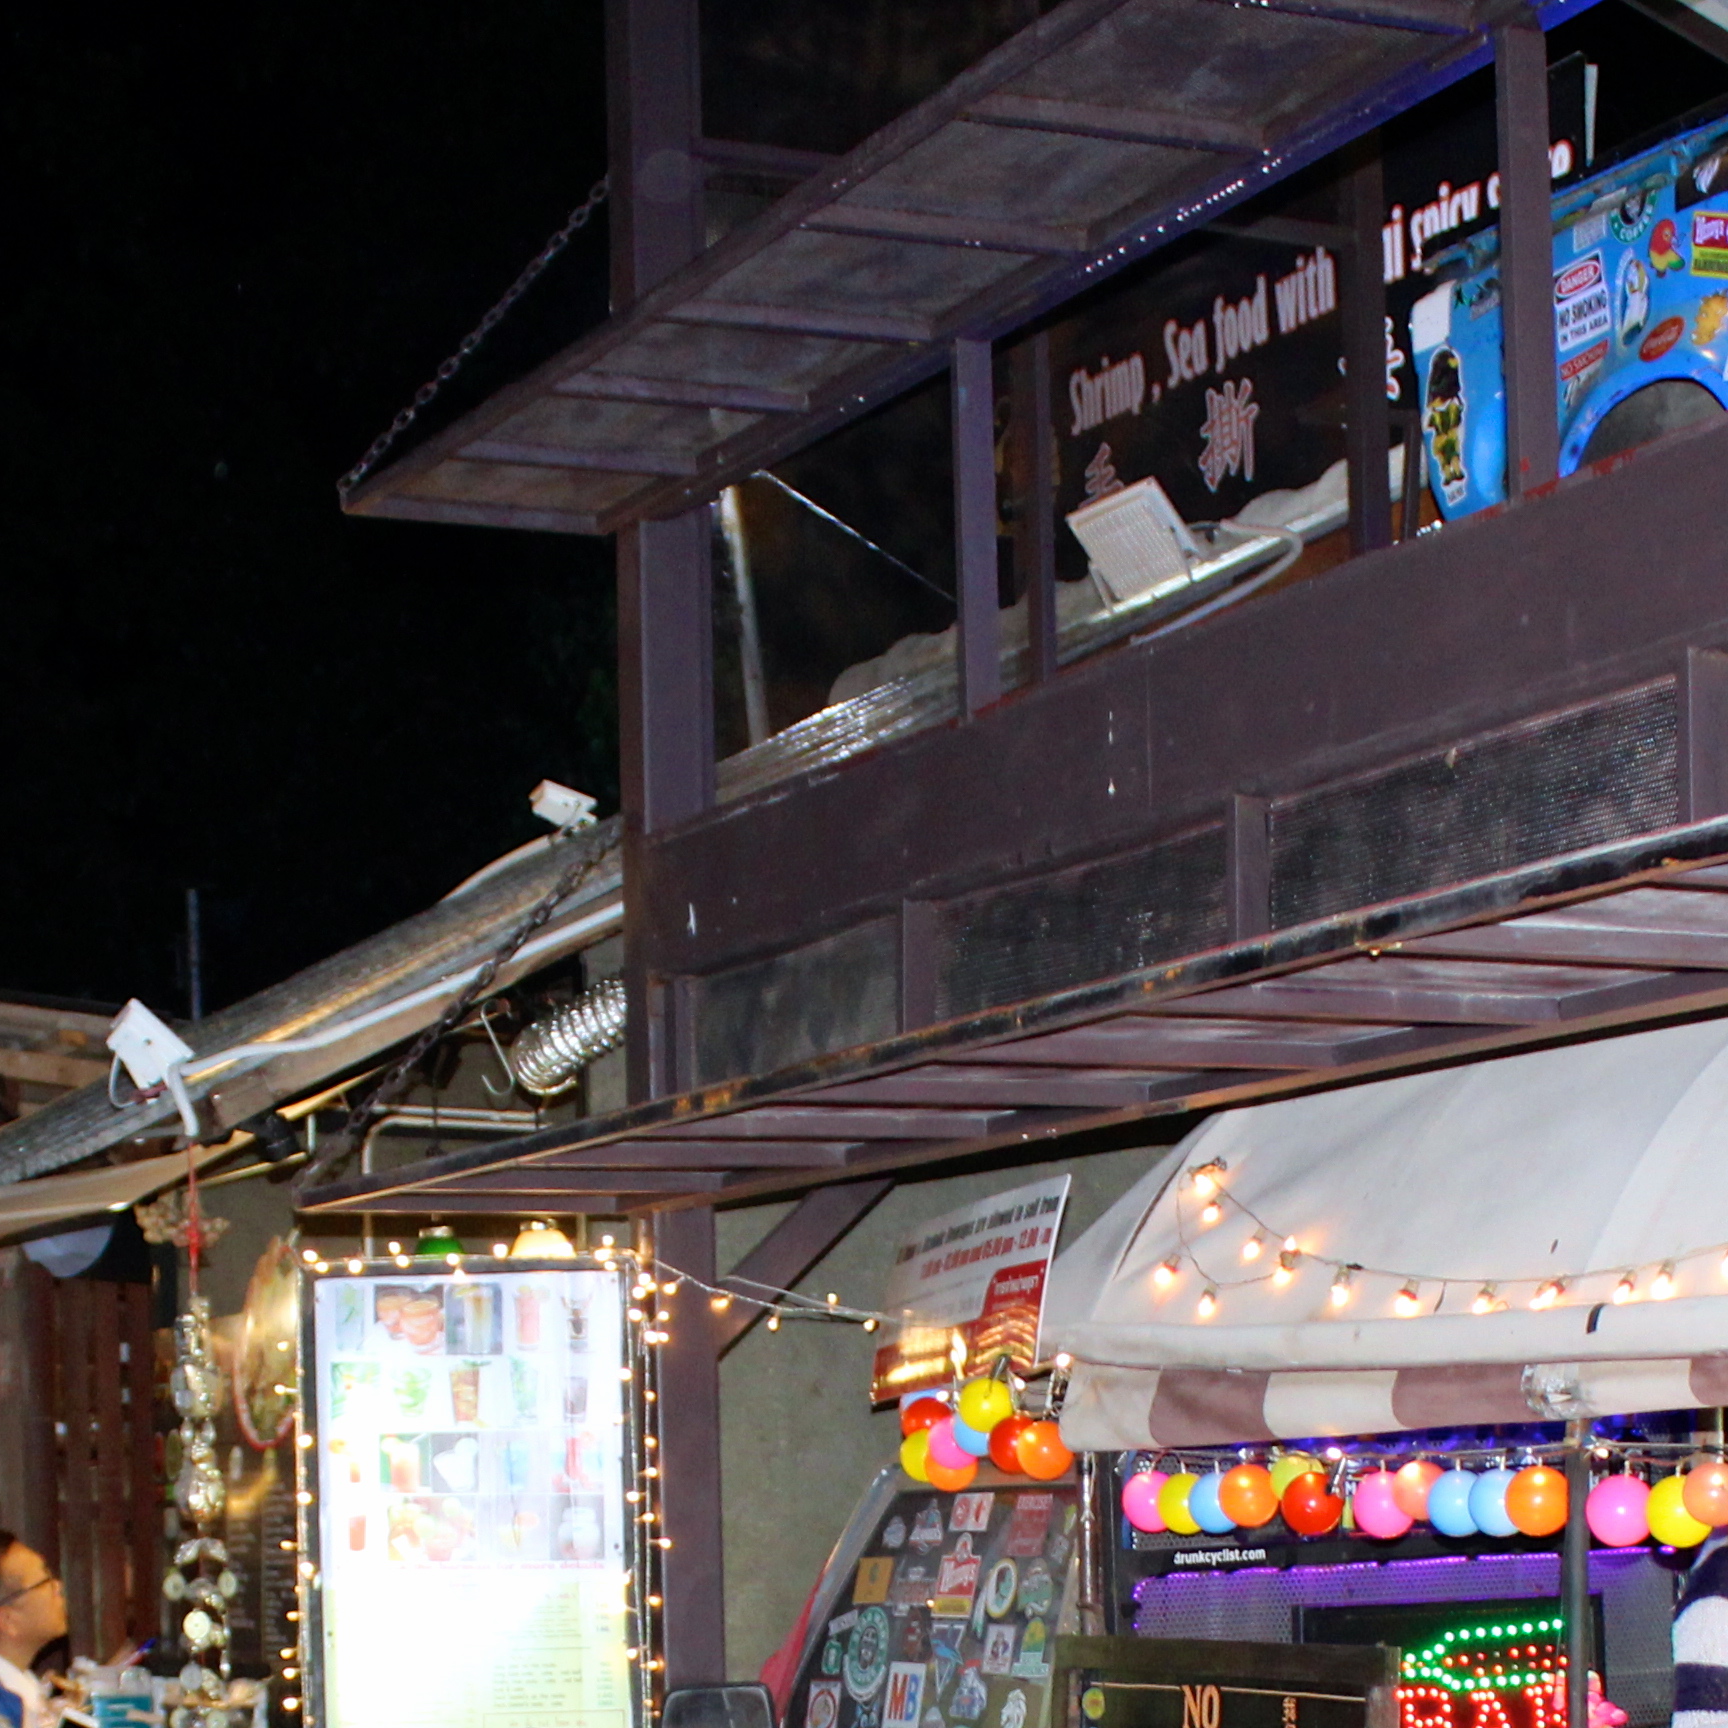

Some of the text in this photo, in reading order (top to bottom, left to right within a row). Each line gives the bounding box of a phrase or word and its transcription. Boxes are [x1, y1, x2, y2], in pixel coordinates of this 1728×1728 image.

[1560, 265, 1595, 293] DANGER
[1163, 318, 1208, 390] Sea
[1214, 272, 1269, 375] food
[1275, 246, 1337, 335] with
[1571, 289, 1607, 323] SMOKING
[1173, 1548, 1266, 1566] drunkcyclist.com
[888, 1672, 920, 1722] MB
